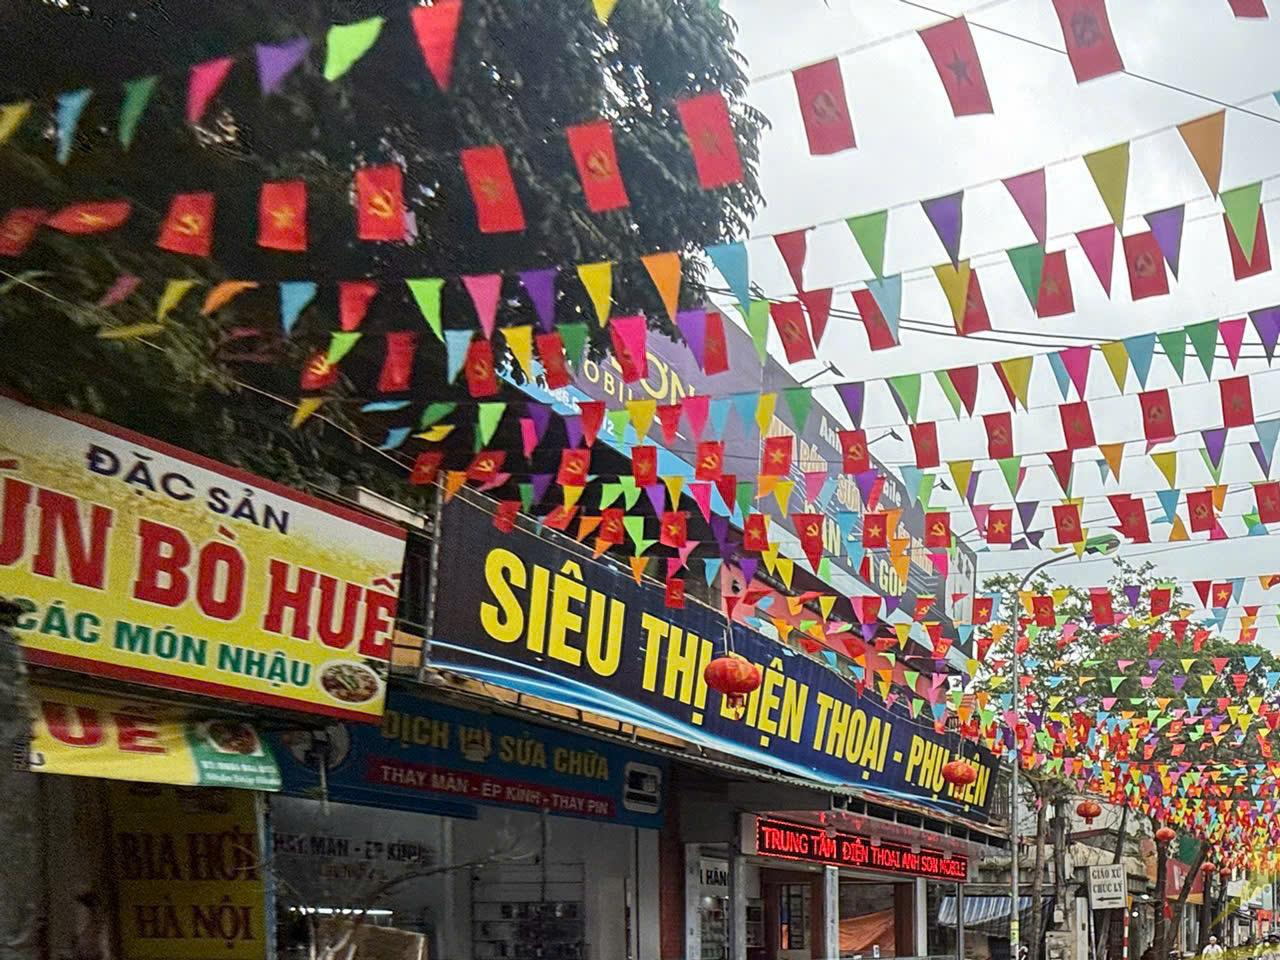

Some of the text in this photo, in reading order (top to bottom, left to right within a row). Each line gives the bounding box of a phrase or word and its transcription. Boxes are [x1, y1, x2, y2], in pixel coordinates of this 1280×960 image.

[86, 444, 290, 535] ĐẶC SẢN
[133, 518, 245, 622] BÒ
[263, 558, 401, 661] HUẾ
[15, 598, 312, 690] CÁC MÓN NHẬU
[480, 548, 624, 677] SIÊU
[642, 612, 711, 725] THỊ
[813, 692, 893, 781] THOẠI
[906, 734, 949, 802] PHỤ
[381, 765, 426, 786] THAY
[552, 794, 584, 812] THAY
[706, 867, 729, 887] HÀN
[762, 827, 808, 854] TRUNG
[812, 832, 837, 859] TÂM
[842, 837, 869, 865] ĐIỆN
[193, 895, 256, 949] NỘI
